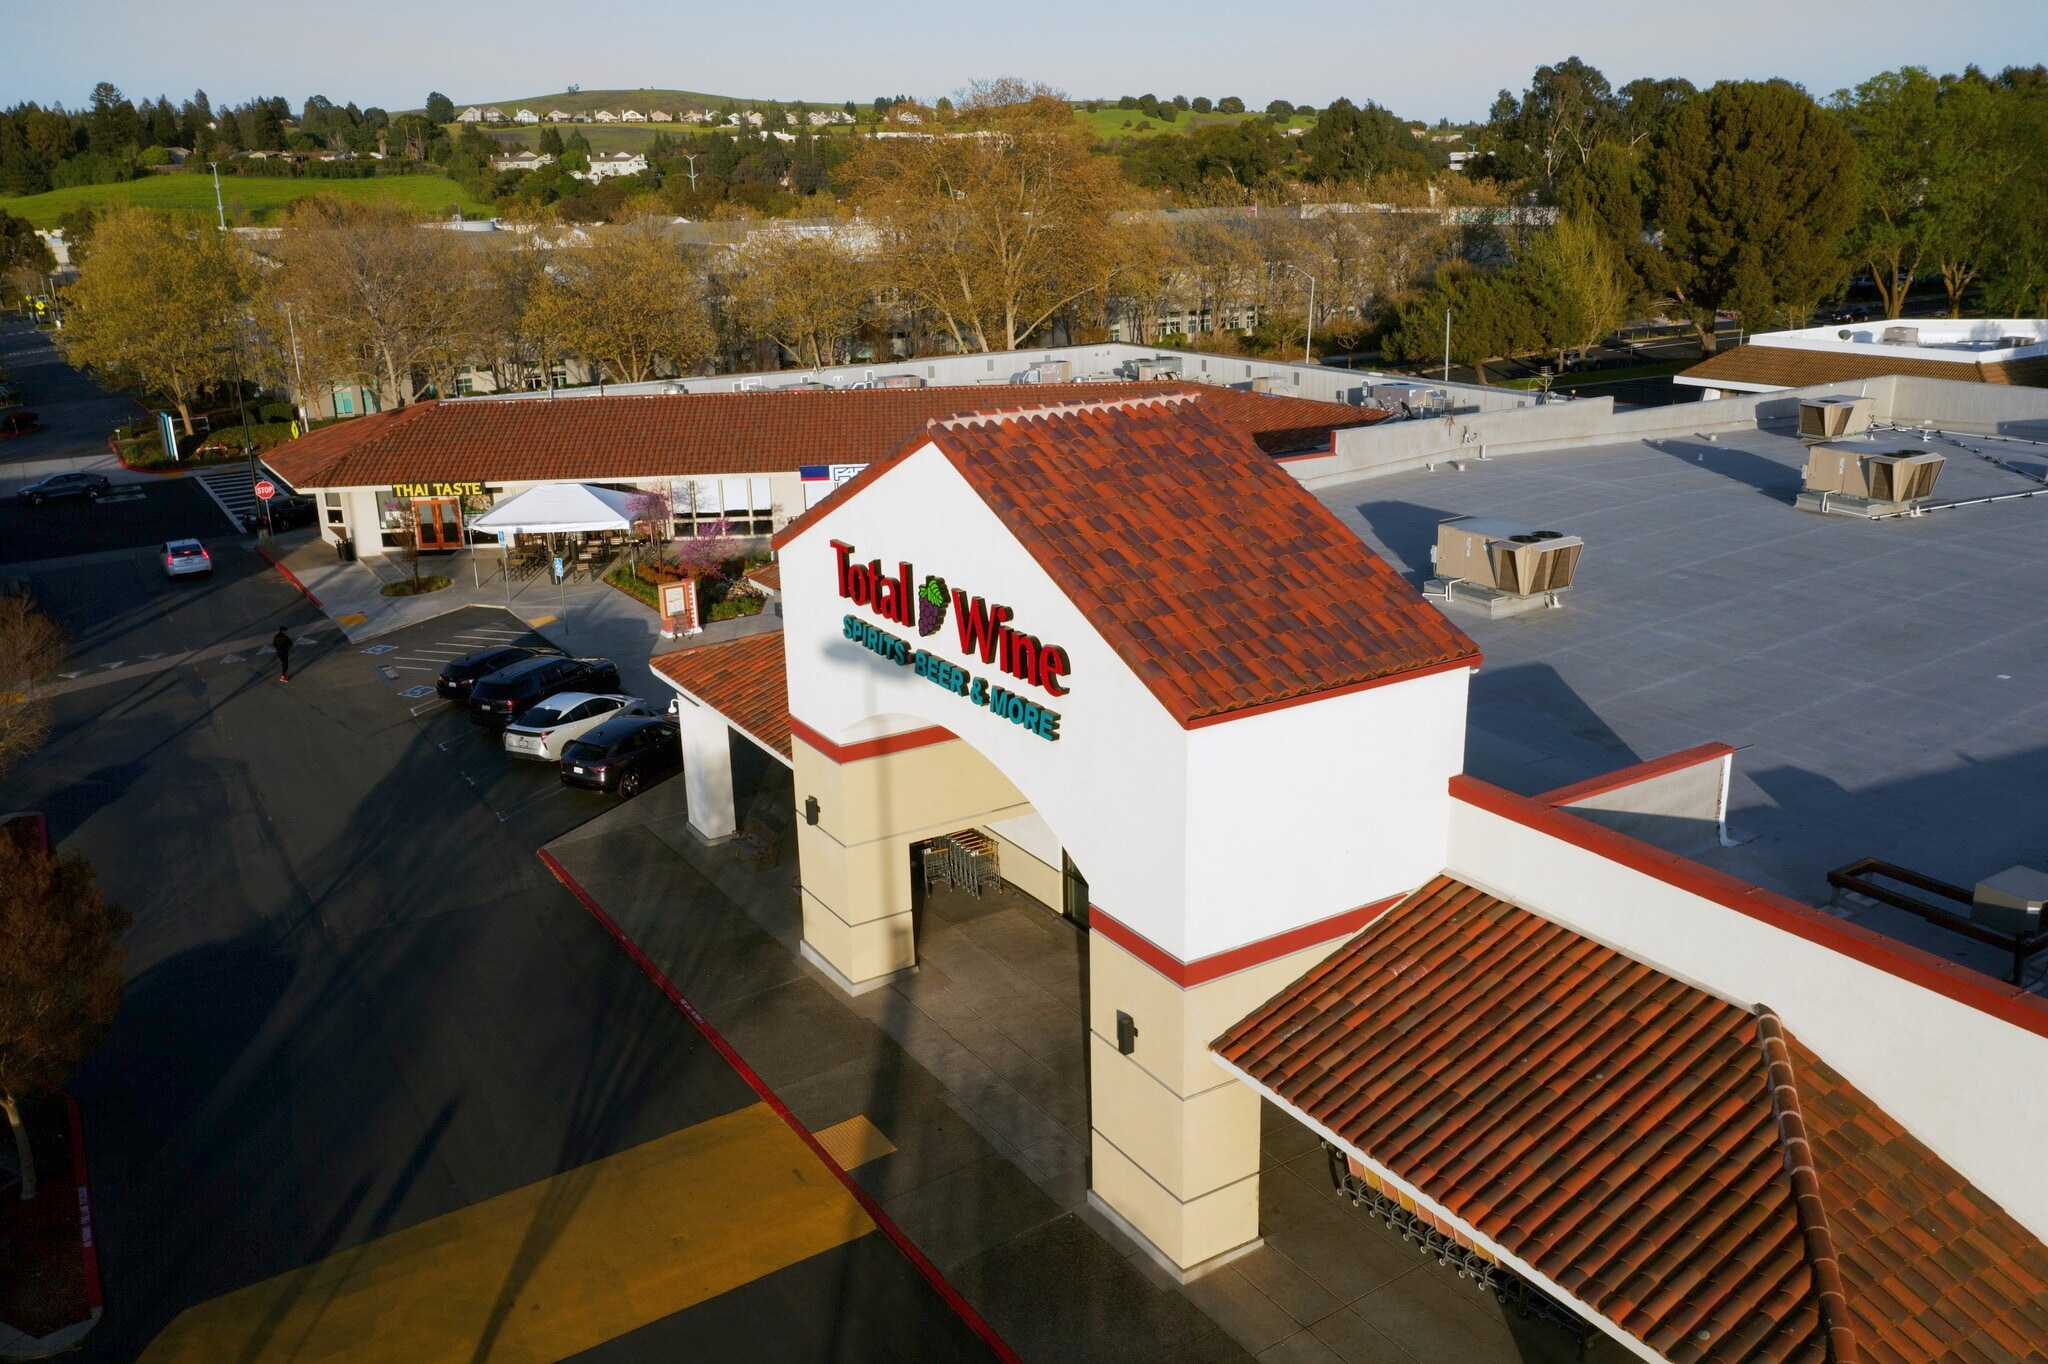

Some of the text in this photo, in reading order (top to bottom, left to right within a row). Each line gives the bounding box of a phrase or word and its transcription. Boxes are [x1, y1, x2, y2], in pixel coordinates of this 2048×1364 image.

[257, 486, 273, 495] STOP
[393, 482, 482, 497] THAI TASTE
[830, 539, 1071, 697] Total Wine
[914, 648, 970, 697] BEER
[970, 676, 990, 706] &
[989, 685, 1061, 742] MORE
